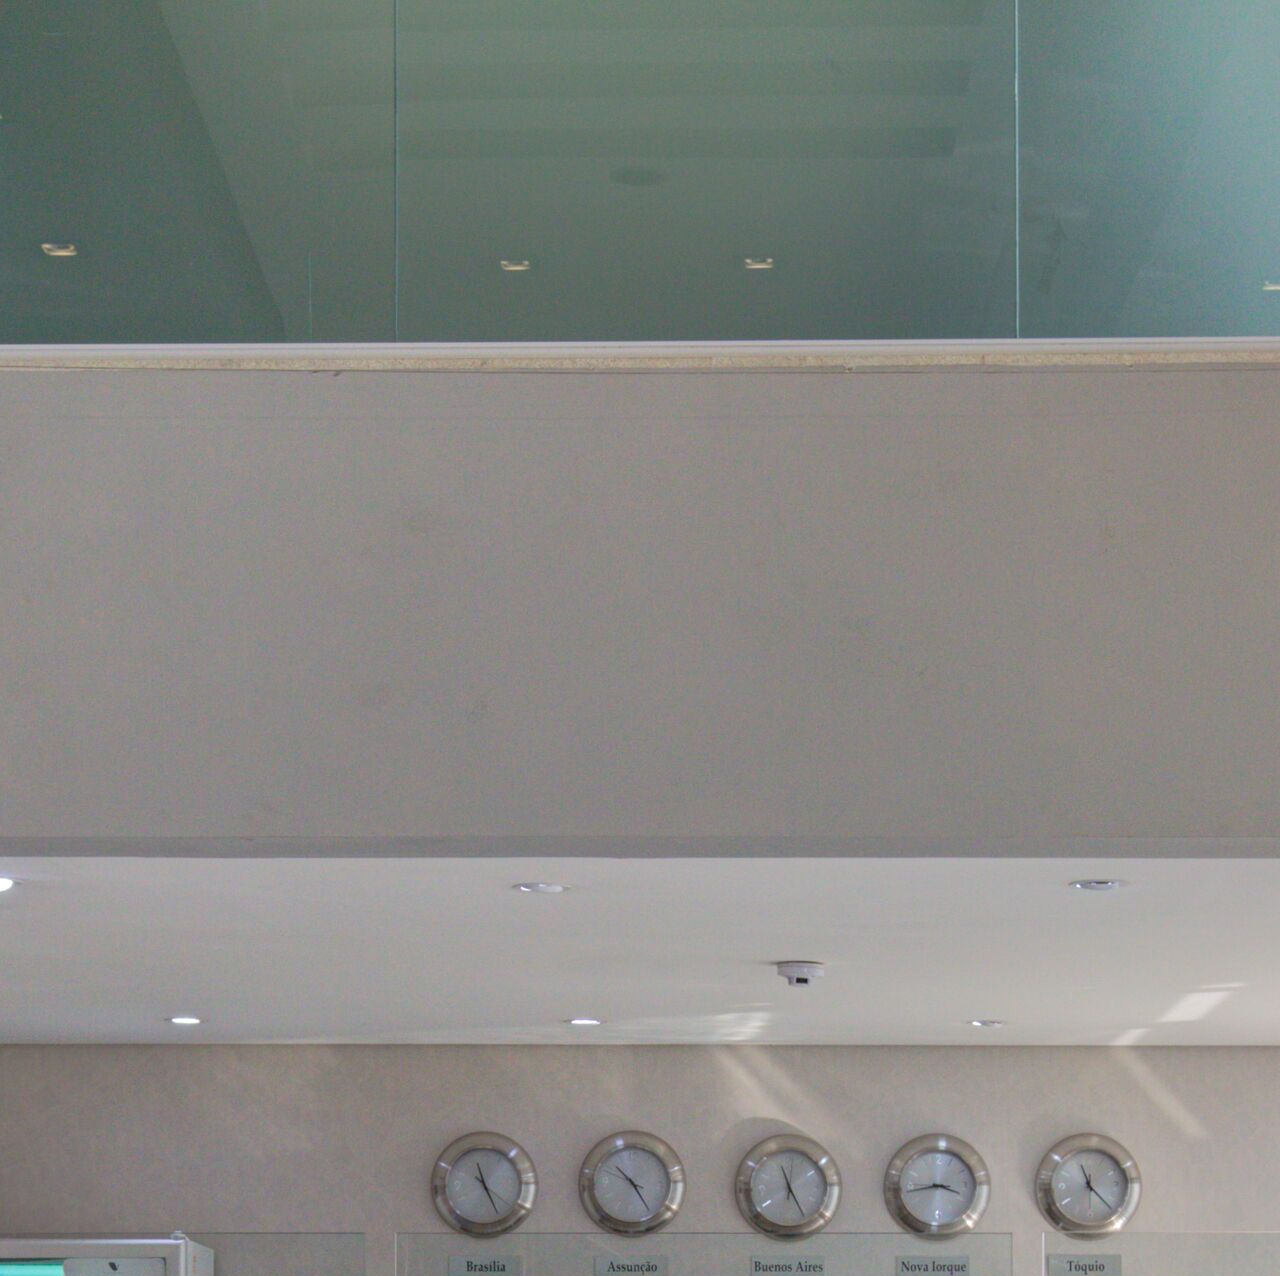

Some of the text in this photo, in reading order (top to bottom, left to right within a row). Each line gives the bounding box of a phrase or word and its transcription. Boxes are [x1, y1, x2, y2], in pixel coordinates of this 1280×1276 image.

[608, 1261, 658, 1276] Assunção
[754, 1261, 824, 1272] Buenos Aires
[901, 1260, 967, 1275] Nova Iorque
[1067, 1260, 1105, 1275] Tóquio
